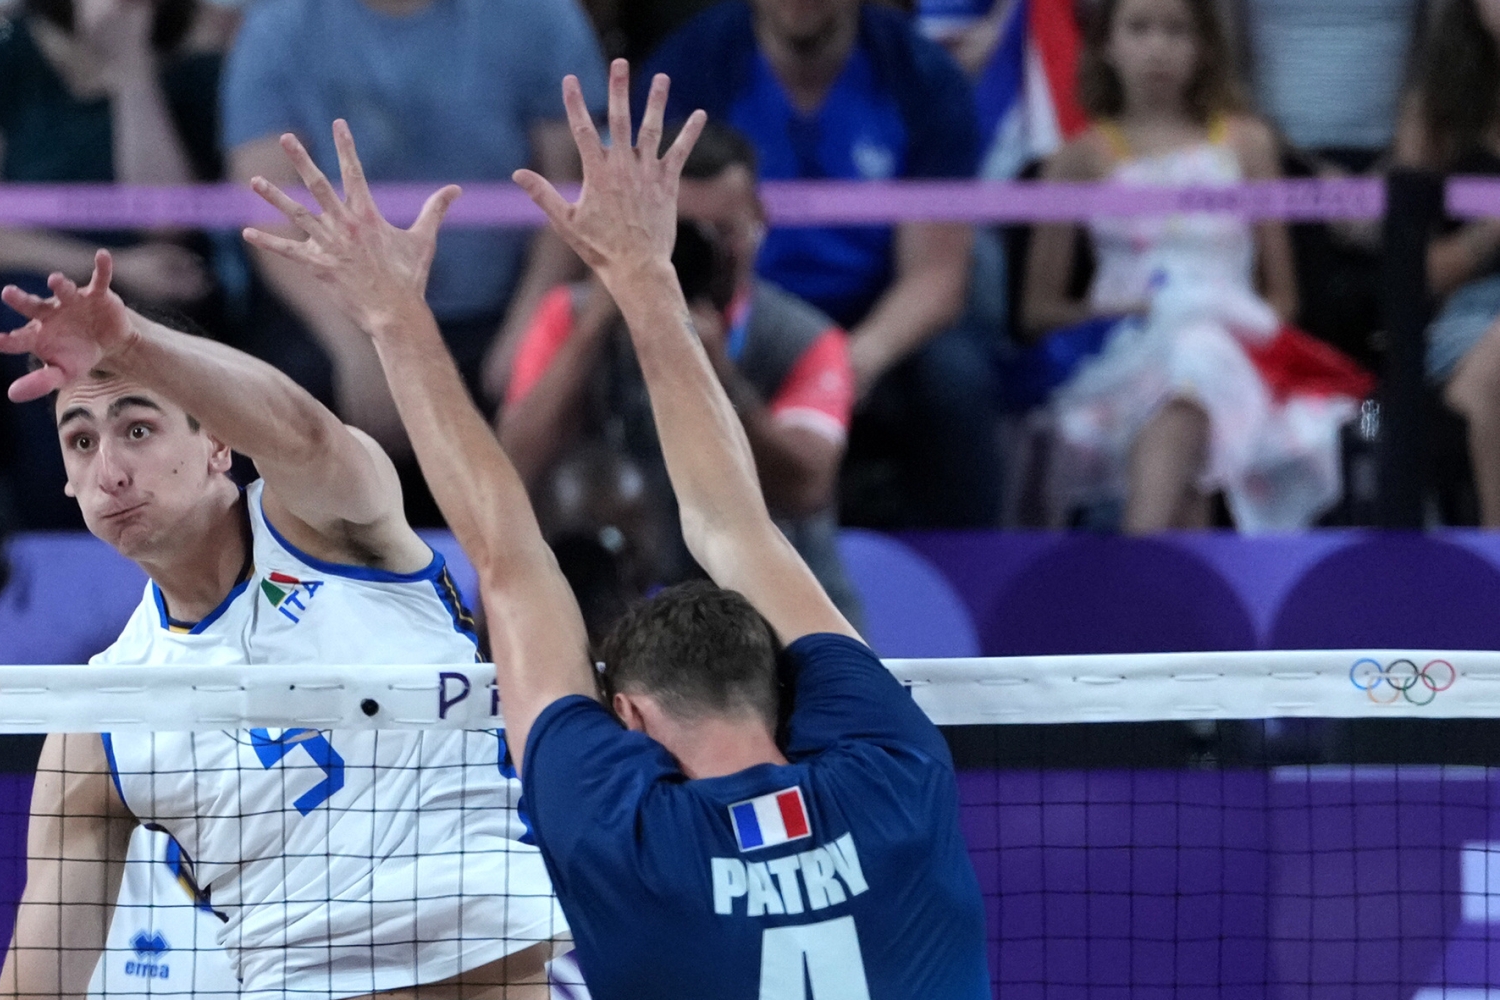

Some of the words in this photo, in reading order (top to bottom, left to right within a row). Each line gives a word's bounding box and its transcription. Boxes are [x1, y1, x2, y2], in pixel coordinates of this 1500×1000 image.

[278, 580, 324, 624] ITA
[711, 831, 870, 917] PATRY
[125, 961, 170, 979] errea
